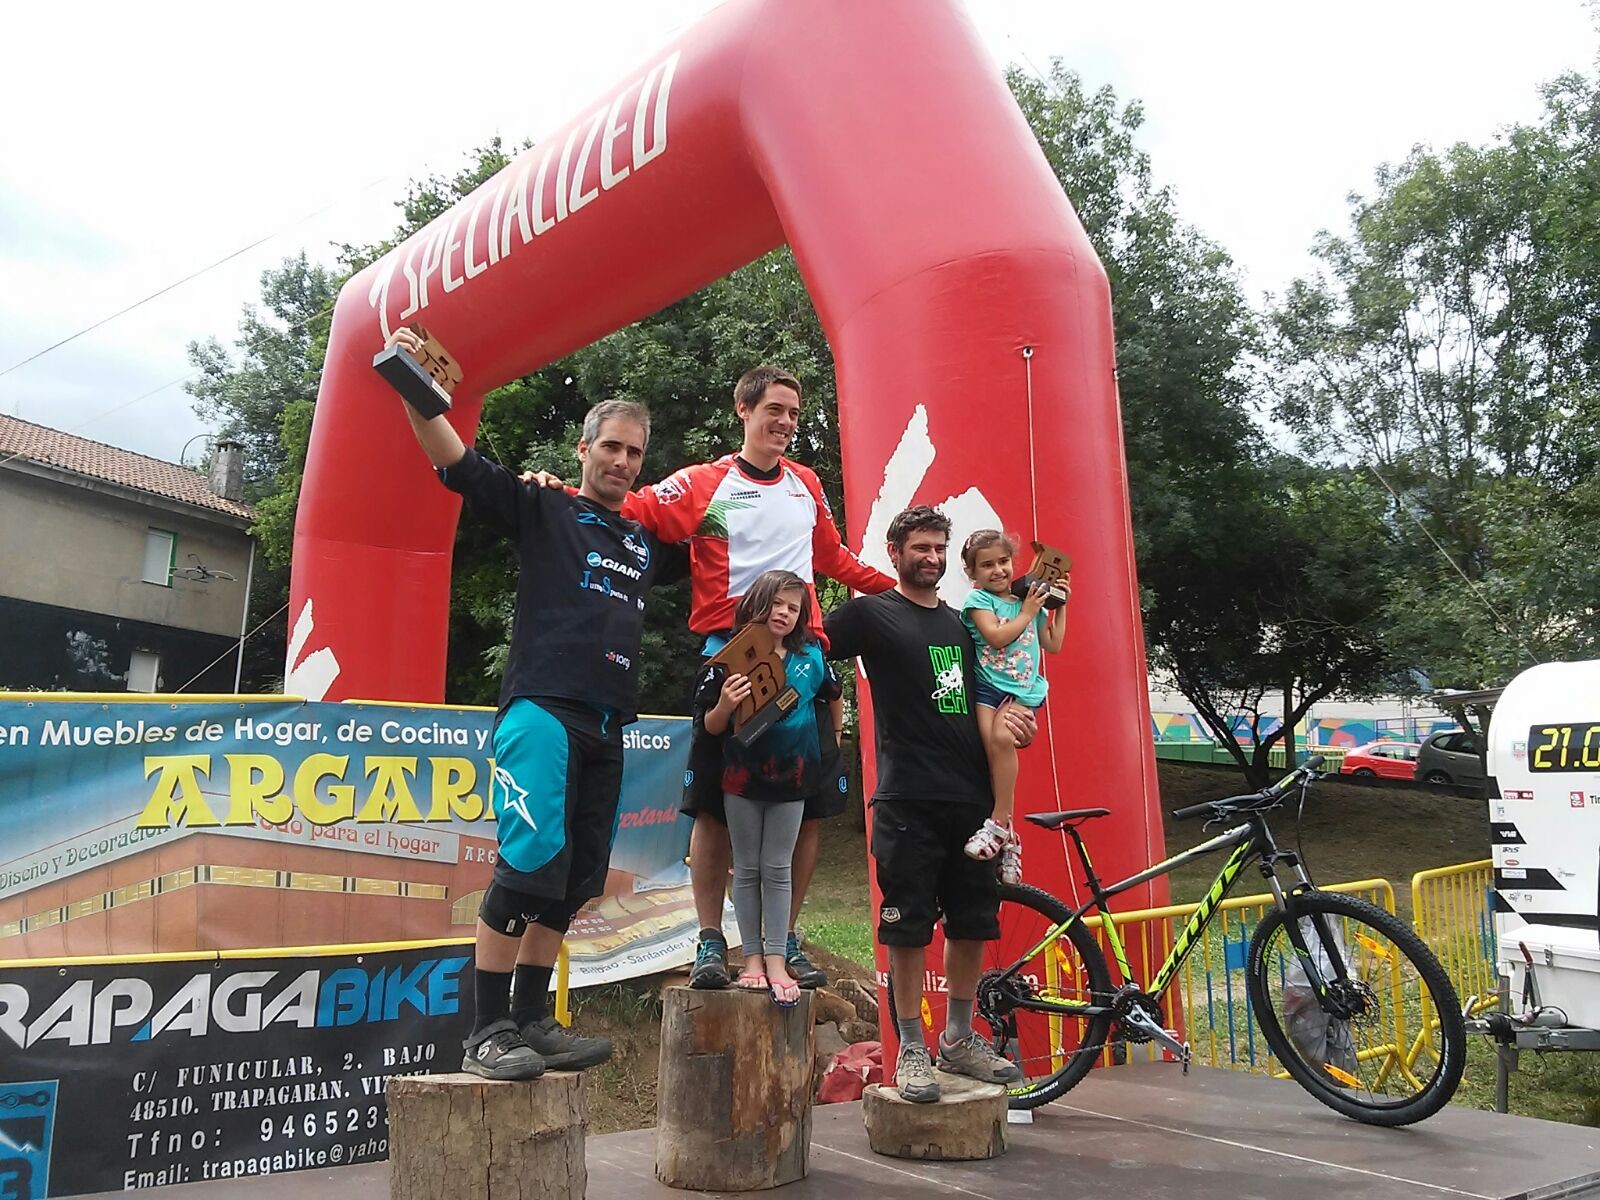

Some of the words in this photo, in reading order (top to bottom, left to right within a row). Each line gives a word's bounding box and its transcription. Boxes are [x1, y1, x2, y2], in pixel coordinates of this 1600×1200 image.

[400, 50, 681, 320] SPECIALIZED
[601, 557, 642, 581] GIANT
[39, 720, 176, 746] Muebles
[185, 720, 224, 742] de
[233, 718, 328, 747] Hogar,
[336, 718, 373, 743] de
[381, 721, 469, 745] Cocina
[476, 729, 489, 750] y
[622, 729, 671, 750] sticos
[310, 823, 358, 843] para
[364, 829, 381, 846] el
[387, 830, 440, 855] hogar
[52, 855, 62, 874] y
[580, 960, 619, 976] Bilbao
[626, 939, 692, 966] Santander,
[132, 1069, 158, 1094] C/
[176, 1055, 323, 1088] FUNICULAR,
[342, 1052, 363, 1072] 2.
[383, 1042, 436, 1067] BAJO
[130, 1098, 200, 1123] 48510.
[211, 1080, 350, 1112] TRAPAGARAN.
[127, 1126, 222, 1159] Tfno:
[124, 1165, 190, 1191] Email:
[201, 1137, 388, 1178] trapagabike@yaho
